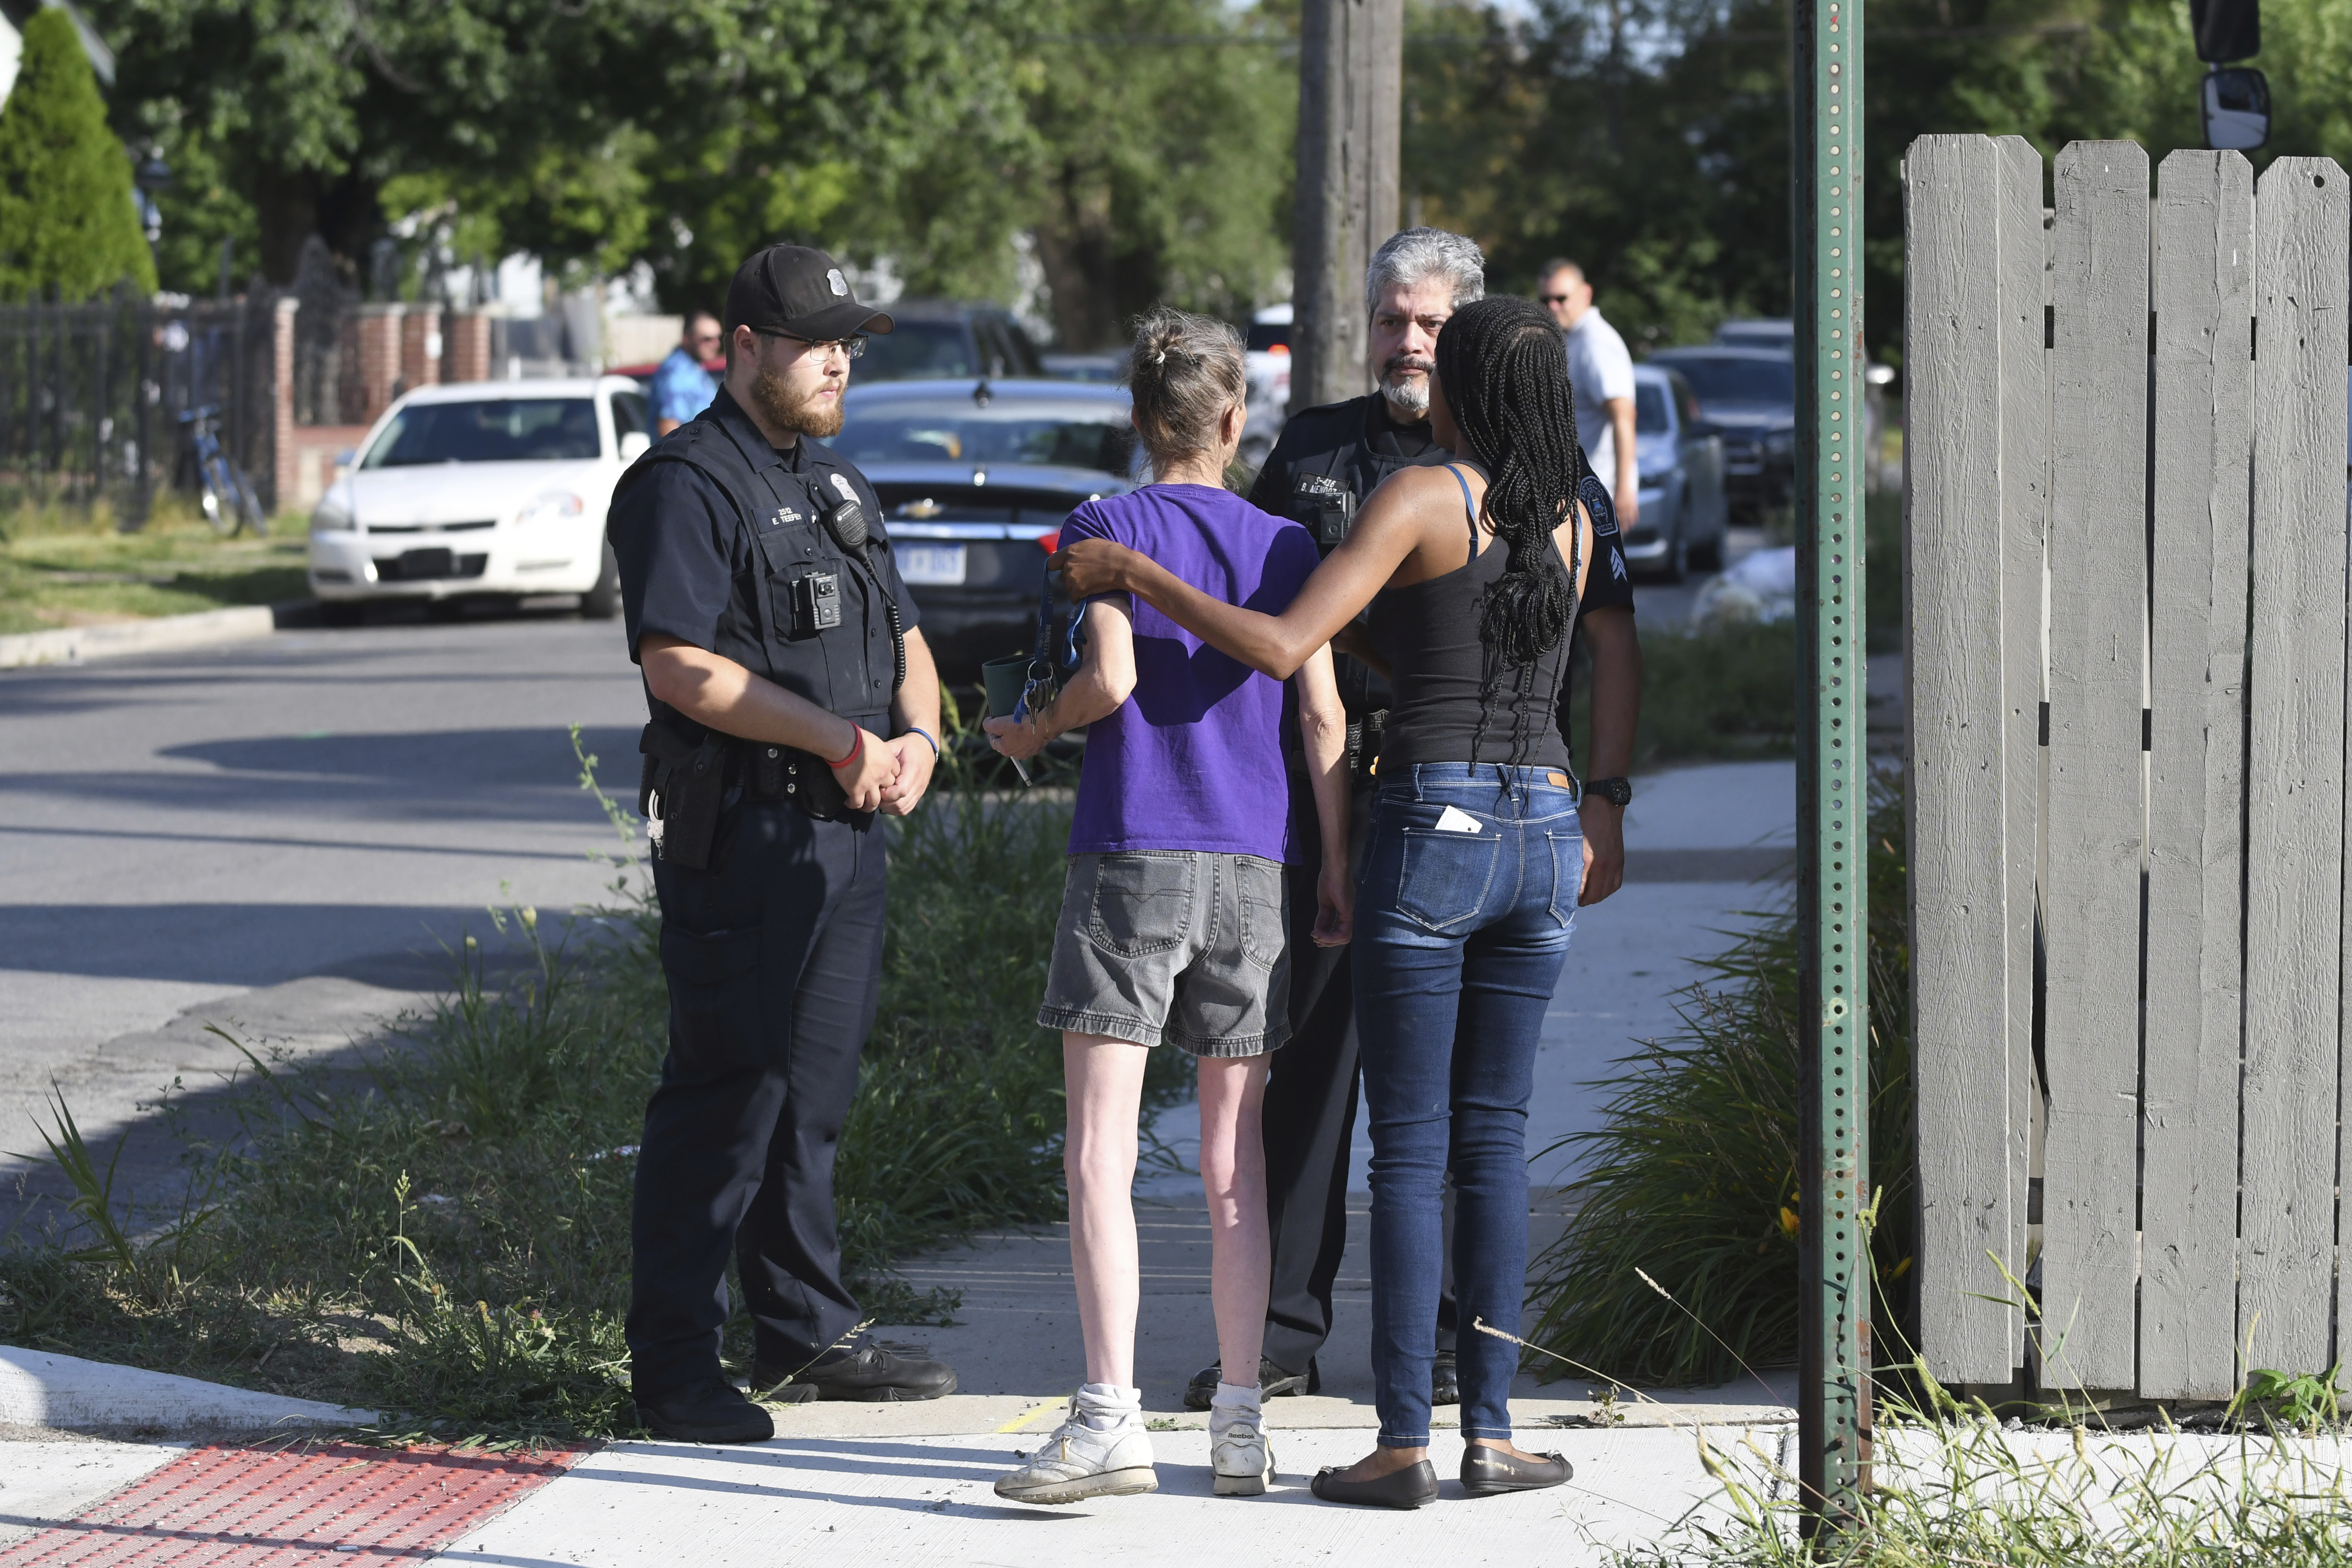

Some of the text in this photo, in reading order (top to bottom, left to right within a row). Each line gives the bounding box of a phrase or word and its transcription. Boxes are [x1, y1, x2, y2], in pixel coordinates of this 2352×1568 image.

[1314, 477, 1336, 488] S-416
[1301, 483, 1339, 494] B. MENDOZ
[778, 507, 793, 516] 2512
[1597, 523, 1614, 532] POLICE
